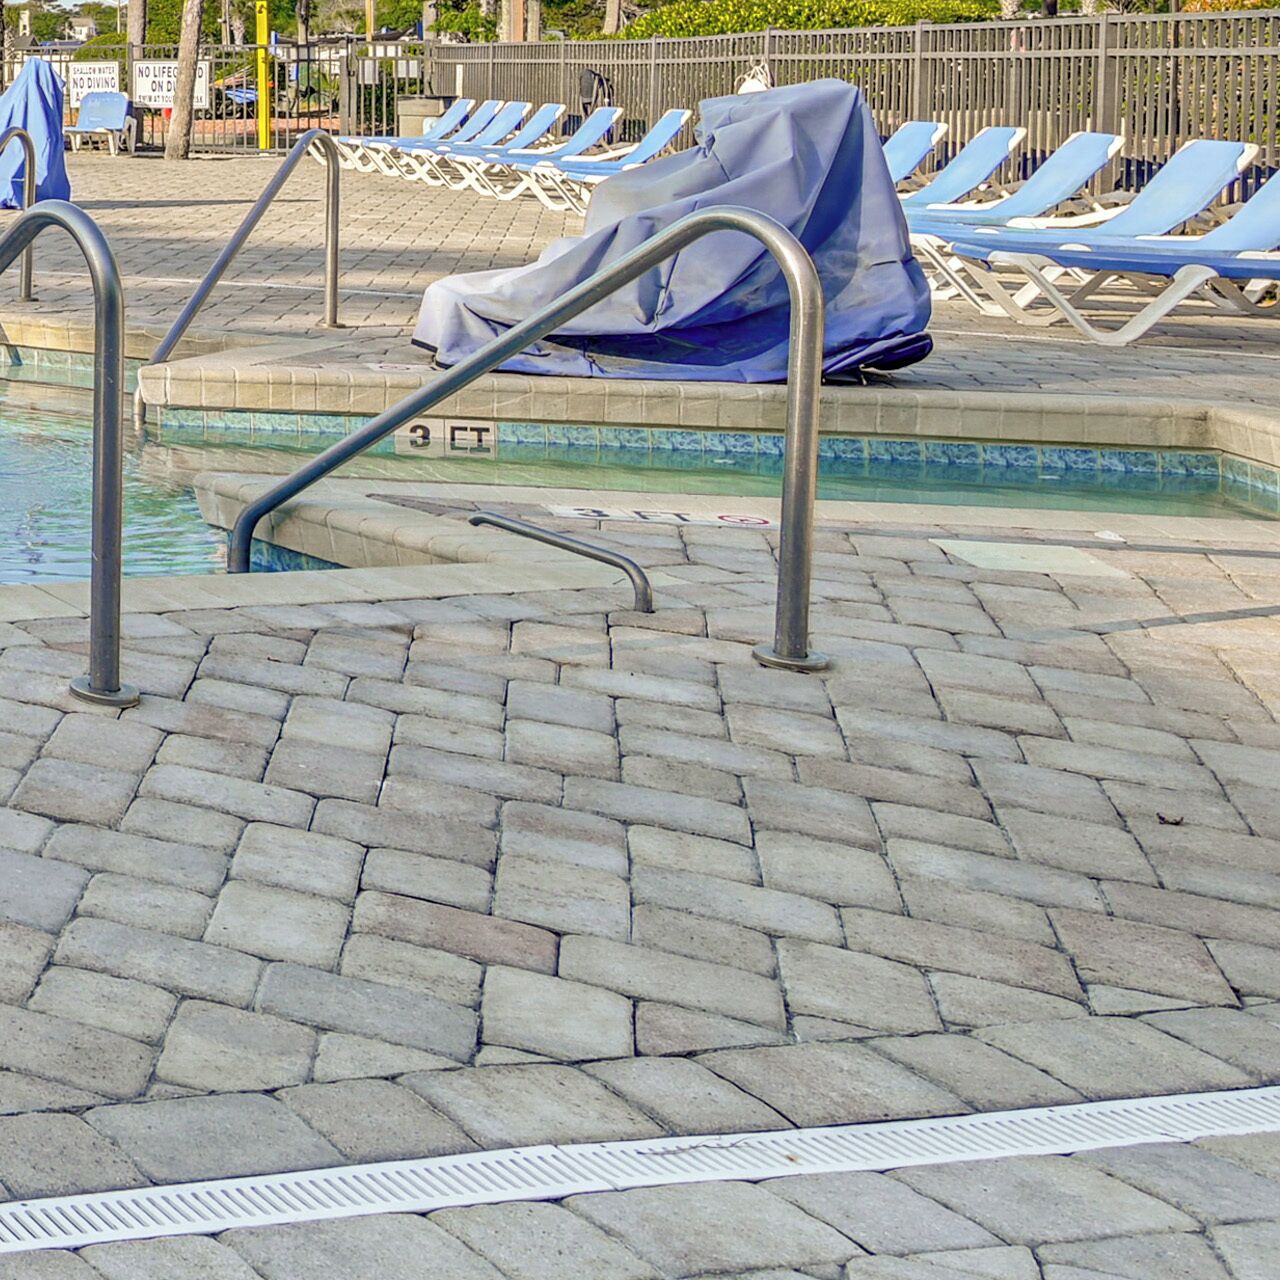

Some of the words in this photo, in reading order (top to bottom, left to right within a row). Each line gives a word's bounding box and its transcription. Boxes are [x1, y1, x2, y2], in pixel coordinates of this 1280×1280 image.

[138, 66, 151, 78] NO
[72, 76, 85, 89] NO
[87, 76, 116, 89] DIVING
[151, 80, 163, 92] ON
[409, 424, 431, 448] 3
[633, 510, 690, 522] FT
